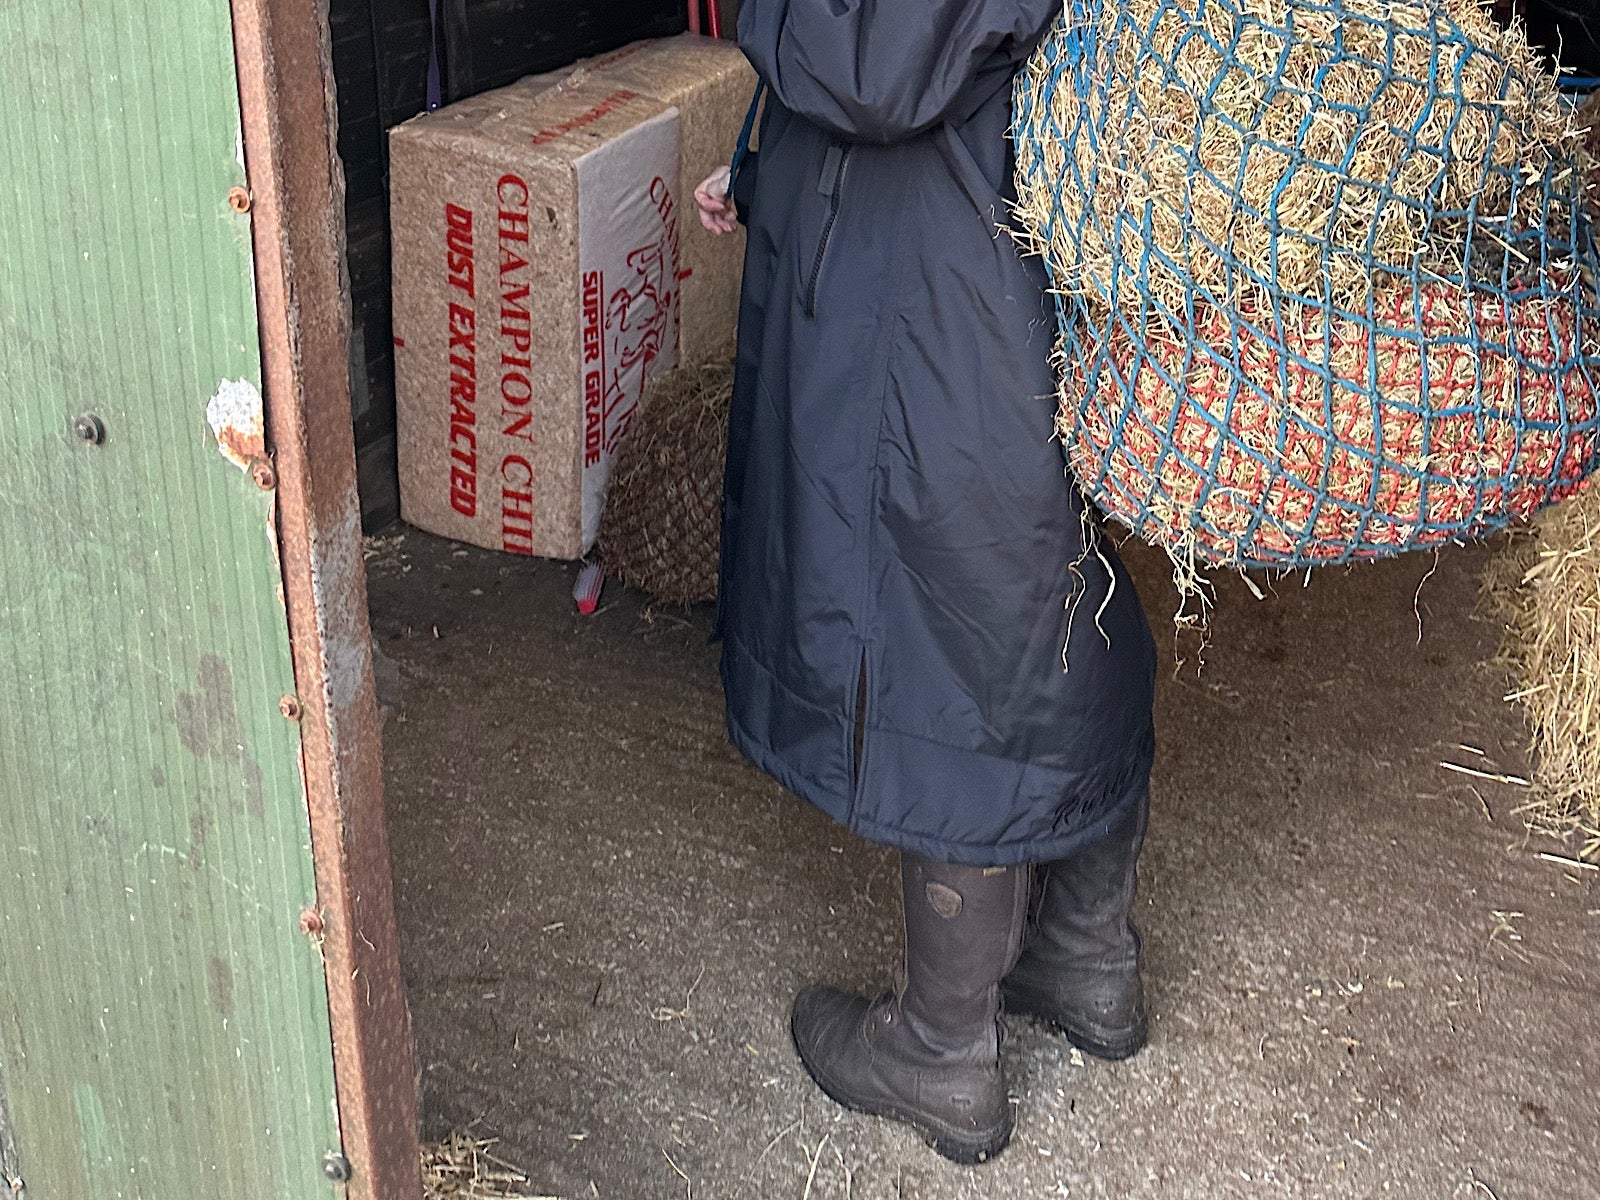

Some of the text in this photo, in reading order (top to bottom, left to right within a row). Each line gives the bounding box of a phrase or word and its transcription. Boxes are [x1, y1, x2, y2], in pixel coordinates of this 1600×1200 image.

[445, 202, 477, 518] DUST EXTRACTED
[497, 174, 533, 442] CHAMPION
[582, 272, 600, 469] SUPER GRADE
